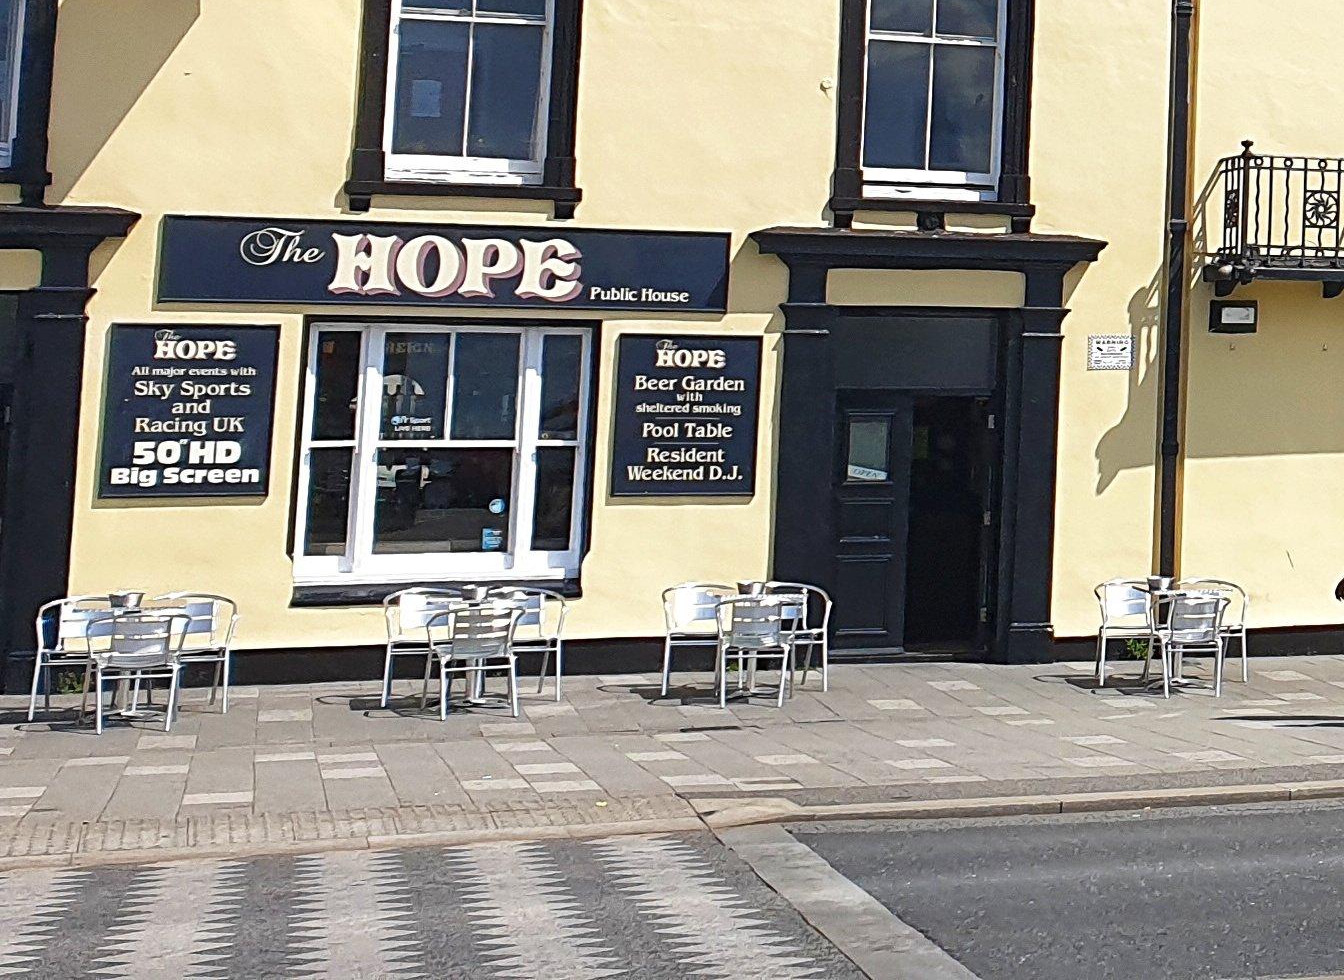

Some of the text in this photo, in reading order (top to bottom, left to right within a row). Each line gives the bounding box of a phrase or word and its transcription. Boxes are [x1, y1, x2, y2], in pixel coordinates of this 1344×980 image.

[240, 227, 583, 301] The HOPE
[590, 286, 689, 303] Public House
[155, 329, 181, 340] The
[154, 340, 237, 360] HOPE
[656, 339, 678, 349] The
[656, 349, 726, 368] HOPE
[131, 367, 256, 377] All major events with
[134, 381, 251, 400] Sky Sports
[634, 375, 745, 391] Beer Garden
[676, 392, 703, 402] with
[171, 400, 211, 414] and
[636, 403, 741, 415] sheltered smoking
[134, 417, 245, 436] Racing UK
[642, 423, 733, 438] Pool Table
[189, 441, 242, 465] HD
[647, 447, 725, 462] Resident
[110, 467, 260, 487] Big Screen
[627, 465, 743, 481] Weekend D.J.
